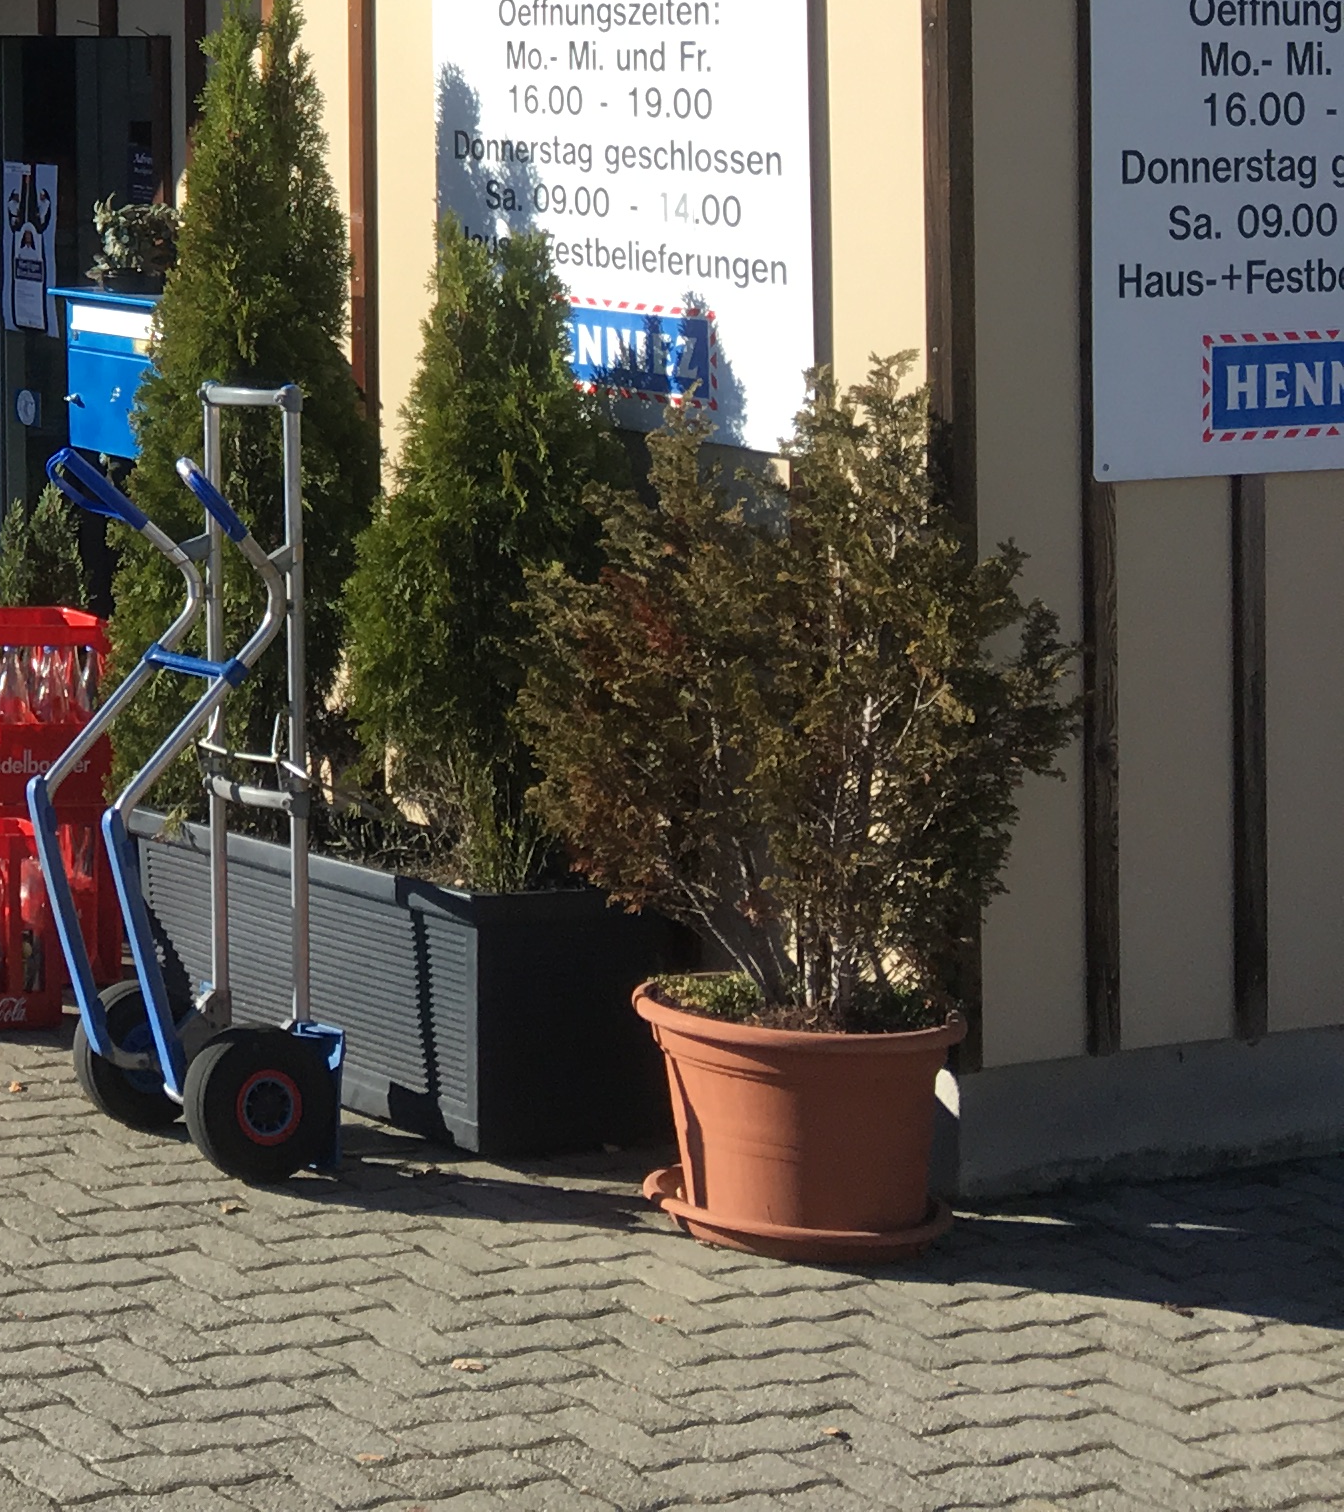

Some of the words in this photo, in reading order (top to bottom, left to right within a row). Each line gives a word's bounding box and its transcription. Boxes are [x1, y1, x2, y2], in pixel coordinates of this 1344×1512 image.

[568, 40, 604, 71] Mi.
[616, 40, 666, 72] und
[680, 40, 712, 72] Fr.
[1286, 41, 1333, 76] Mi.
[509, 84, 583, 116] 16.00
[628, 86, 713, 120] 19.00
[1203, 91, 1306, 128] 16.00
[453, 129, 593, 174] Donnerstag
[604, 139, 783, 177] geschlossen
[1121, 148, 1318, 190] Donnerstag
[485, 179, 523, 212] Sa.
[533, 182, 611, 218] 09.00
[1168, 204, 1223, 241] Sa.
[1237, 202, 1339, 239] 09.00
